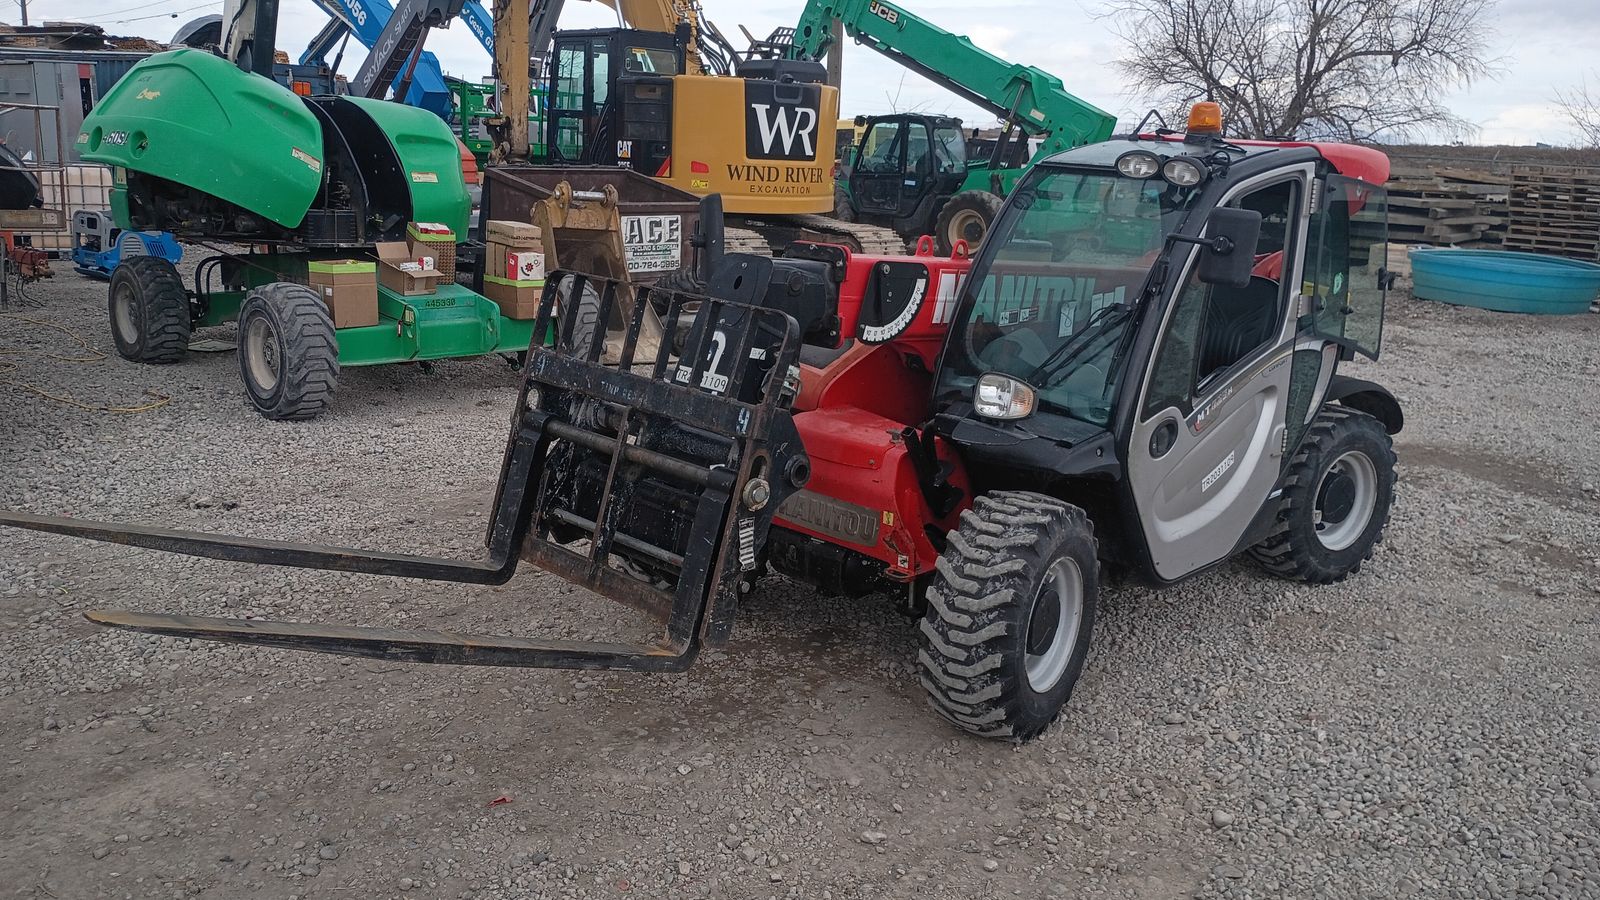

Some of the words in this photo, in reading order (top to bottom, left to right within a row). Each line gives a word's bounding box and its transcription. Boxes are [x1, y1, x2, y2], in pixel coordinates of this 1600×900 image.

[869, 1, 899, 24] JCB
[468, 14, 484, 40] Genie
[363, 36, 395, 88] SKYJACK
[752, 103, 817, 156] WR
[617, 140, 633, 158] CAT
[726, 163, 780, 182] WIND
[785, 166, 823, 184] RIVER
[749, 184, 811, 195] EXCAVATION
[625, 216, 679, 244] ACE
